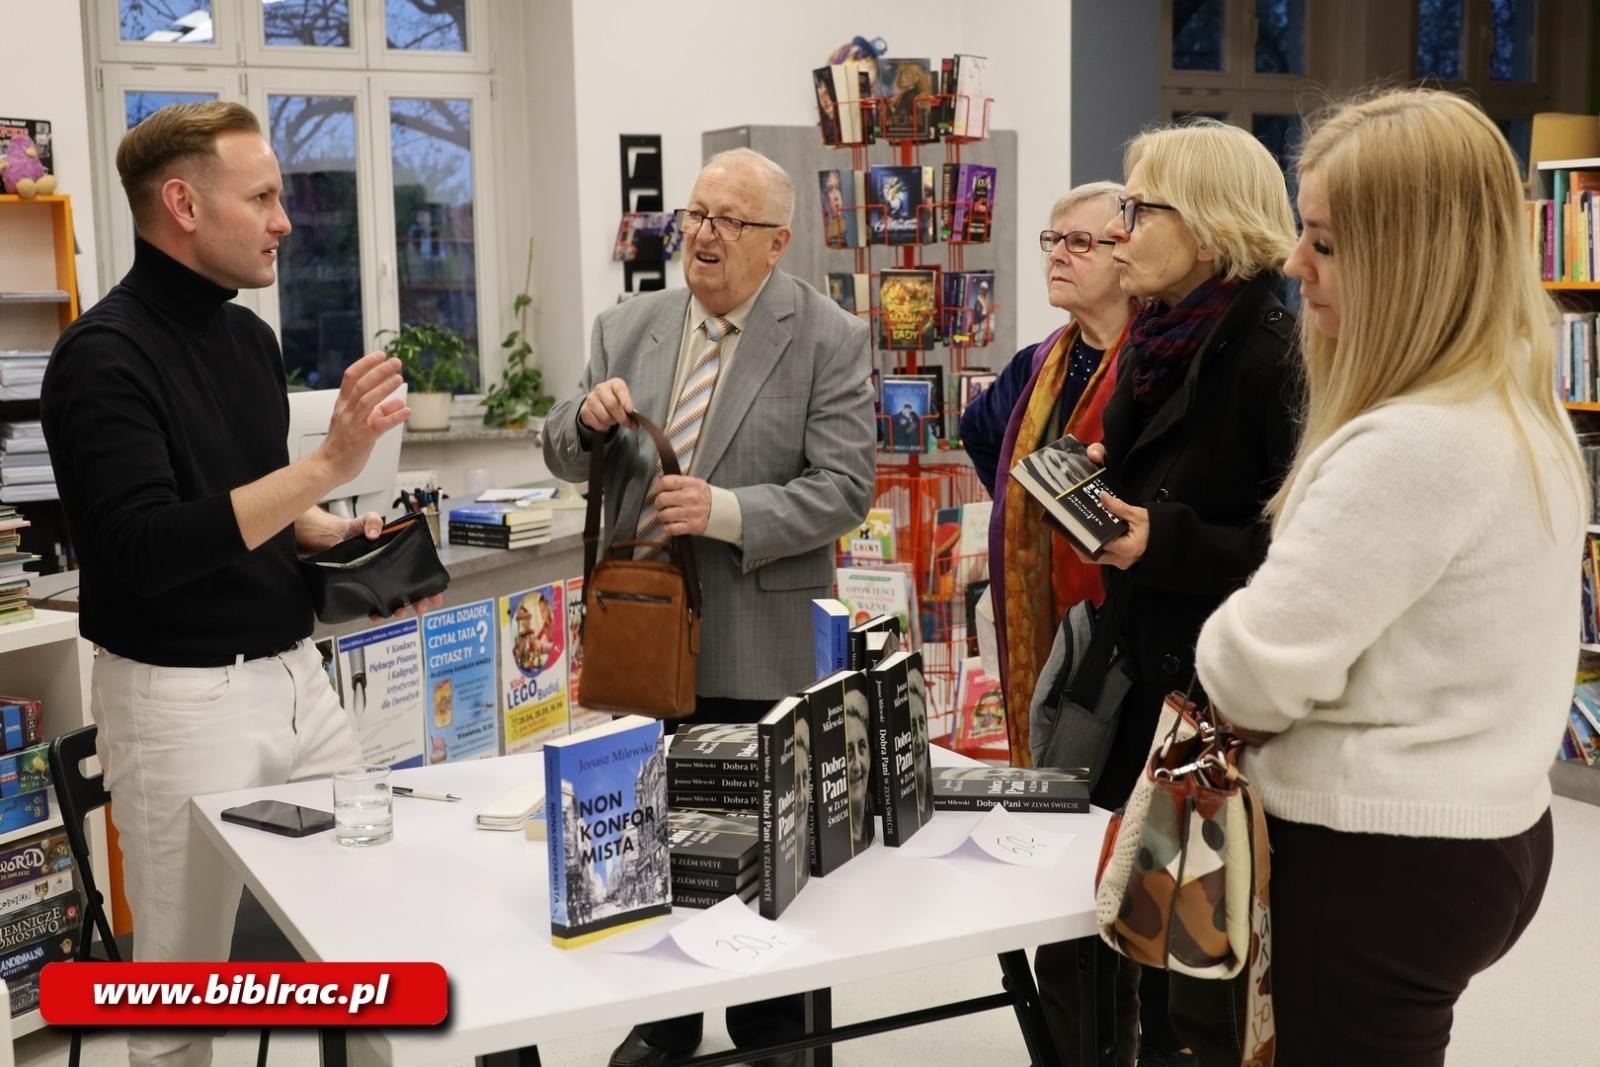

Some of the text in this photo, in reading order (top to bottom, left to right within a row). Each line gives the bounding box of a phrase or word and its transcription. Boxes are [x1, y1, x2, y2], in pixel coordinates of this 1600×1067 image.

[427, 612, 455, 630] CZYTAŁ
[429, 632, 456, 649] CZYTAŁ
[457, 626, 477, 642] TATA
[430, 649, 462, 668] CZYTASZ
[463, 645, 473, 659] TY
[507, 678, 537, 710] LEGO
[880, 729, 888, 755] Dobra
[894, 731, 912, 752] Dobra
[579, 741, 654, 776] Jonasz Milewski
[722, 762, 749, 771] Dobra
[821, 756, 846, 779] Dobra
[882, 757, 890, 776] Pani
[896, 744, 913, 776] Pani
[721, 778, 747, 787] Dobra
[822, 769, 848, 803] Pani
[579, 790, 623, 819] NON
[723, 795, 749, 804] Dobra
[976, 799, 999, 808] Dobr
[1003, 800, 1021, 808] Pani
[1031, 801, 1050, 809] ZŁYM
[1050, 800, 1079, 809] ŚWIECIE
[580, 805, 655, 843] KONFOR
[581, 836, 635, 868] MISTA
